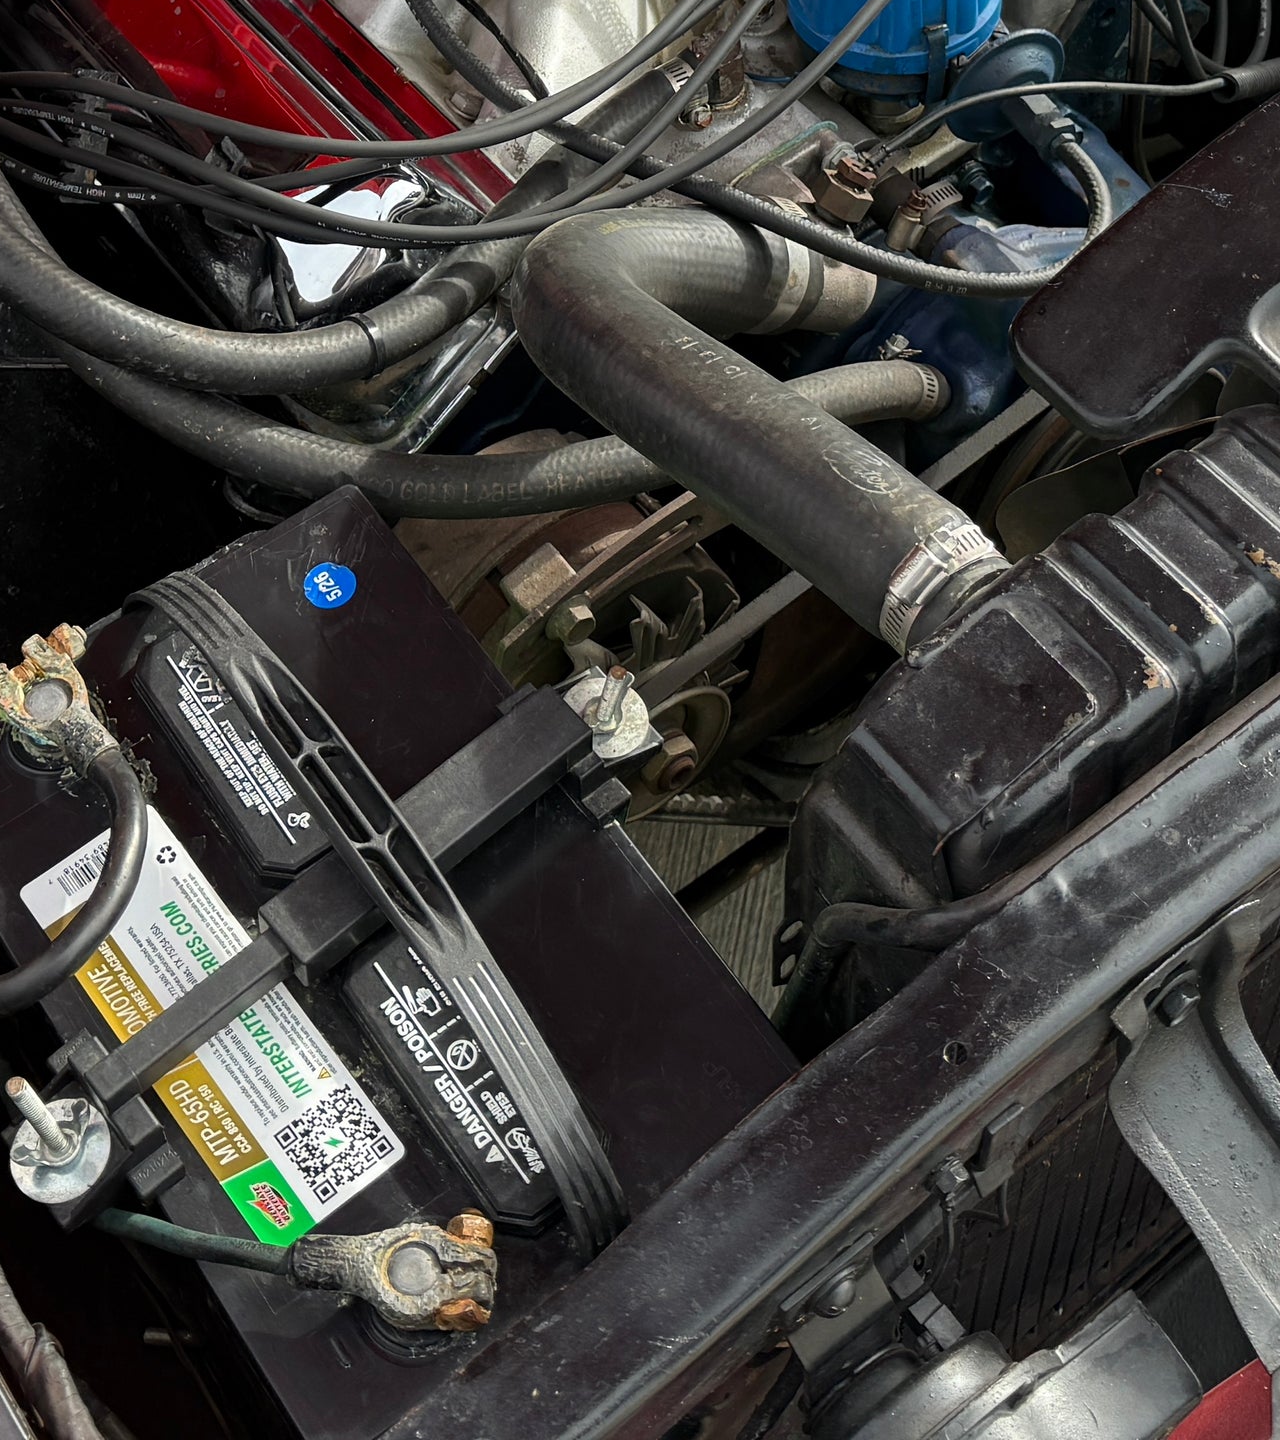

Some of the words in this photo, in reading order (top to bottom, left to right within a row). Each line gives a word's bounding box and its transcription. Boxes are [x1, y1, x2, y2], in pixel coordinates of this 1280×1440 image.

[31, 172, 82, 193] TEMPERATURE
[86, 188, 106, 196] HIGH
[126, 192, 146, 201] 7mm
[463, 481, 532, 504] LABEL
[313, 570, 342, 602] 5/26
[177, 684, 194, 704] LEVEL
[177, 699, 202, 731] CHILDREN
[188, 701, 202, 717] AND
[196, 727, 208, 740] OF
[197, 713, 214, 734] TIGHT
[209, 731, 225, 749] CAPS
[218, 717, 257, 767] IMMEDIATELY
[245, 737, 262, 755] GET
[214, 755, 229, 770] THE
[219, 746, 235, 765] VENT
[223, 767, 234, 779] OF
[229, 761, 245, 780] KEEP
[249, 762, 268, 784] EYES
[228, 776, 243, 792] OUT
[239, 777, 254, 792] TIP.
[260, 779, 284, 808] FLUSH
[273, 778, 293, 801] WITH
[237, 788, 254, 808] KEEP
[248, 789, 263, 805] NOT
[257, 802, 269, 815] DO
[62, 853, 90, 875] 34918
[148, 921, 164, 939] USA
[139, 946, 155, 966] limited
[158, 935, 178, 959] 75254
[151, 963, 161, 974] For
[154, 951, 176, 978] authorized
[172, 956, 186, 969] TX
[130, 988, 151, 1012] FREE
[378, 995, 433, 1064] POISON
[227, 1032, 256, 1068] Interstate
[307, 1036, 329, 1063] reproductive
[222, 1062, 242, 1086] warranty
[250, 1063, 264, 1077] by
[196, 1082, 215, 1102] 150
[237, 1083, 252, 1101] under
[257, 1073, 289, 1113] Distributed
[207, 1097, 224, 1115] RC
[248, 1097, 266, 1119] replace
[268, 1108, 278, 1119] see
[432, 1072, 493, 1149] DANGER
[477, 1088, 509, 1126] SHIELD
[493, 1090, 518, 1118] EYES
[166, 1075, 240, 1168] MTP-65HD
[220, 1115, 239, 1136] 850
[260, 1116, 270, 1126] To
[231, 1131, 253, 1155] CCA
[251, 1184, 285, 1228] INTERSTATE
[259, 1182, 290, 1222] BATTERIES
